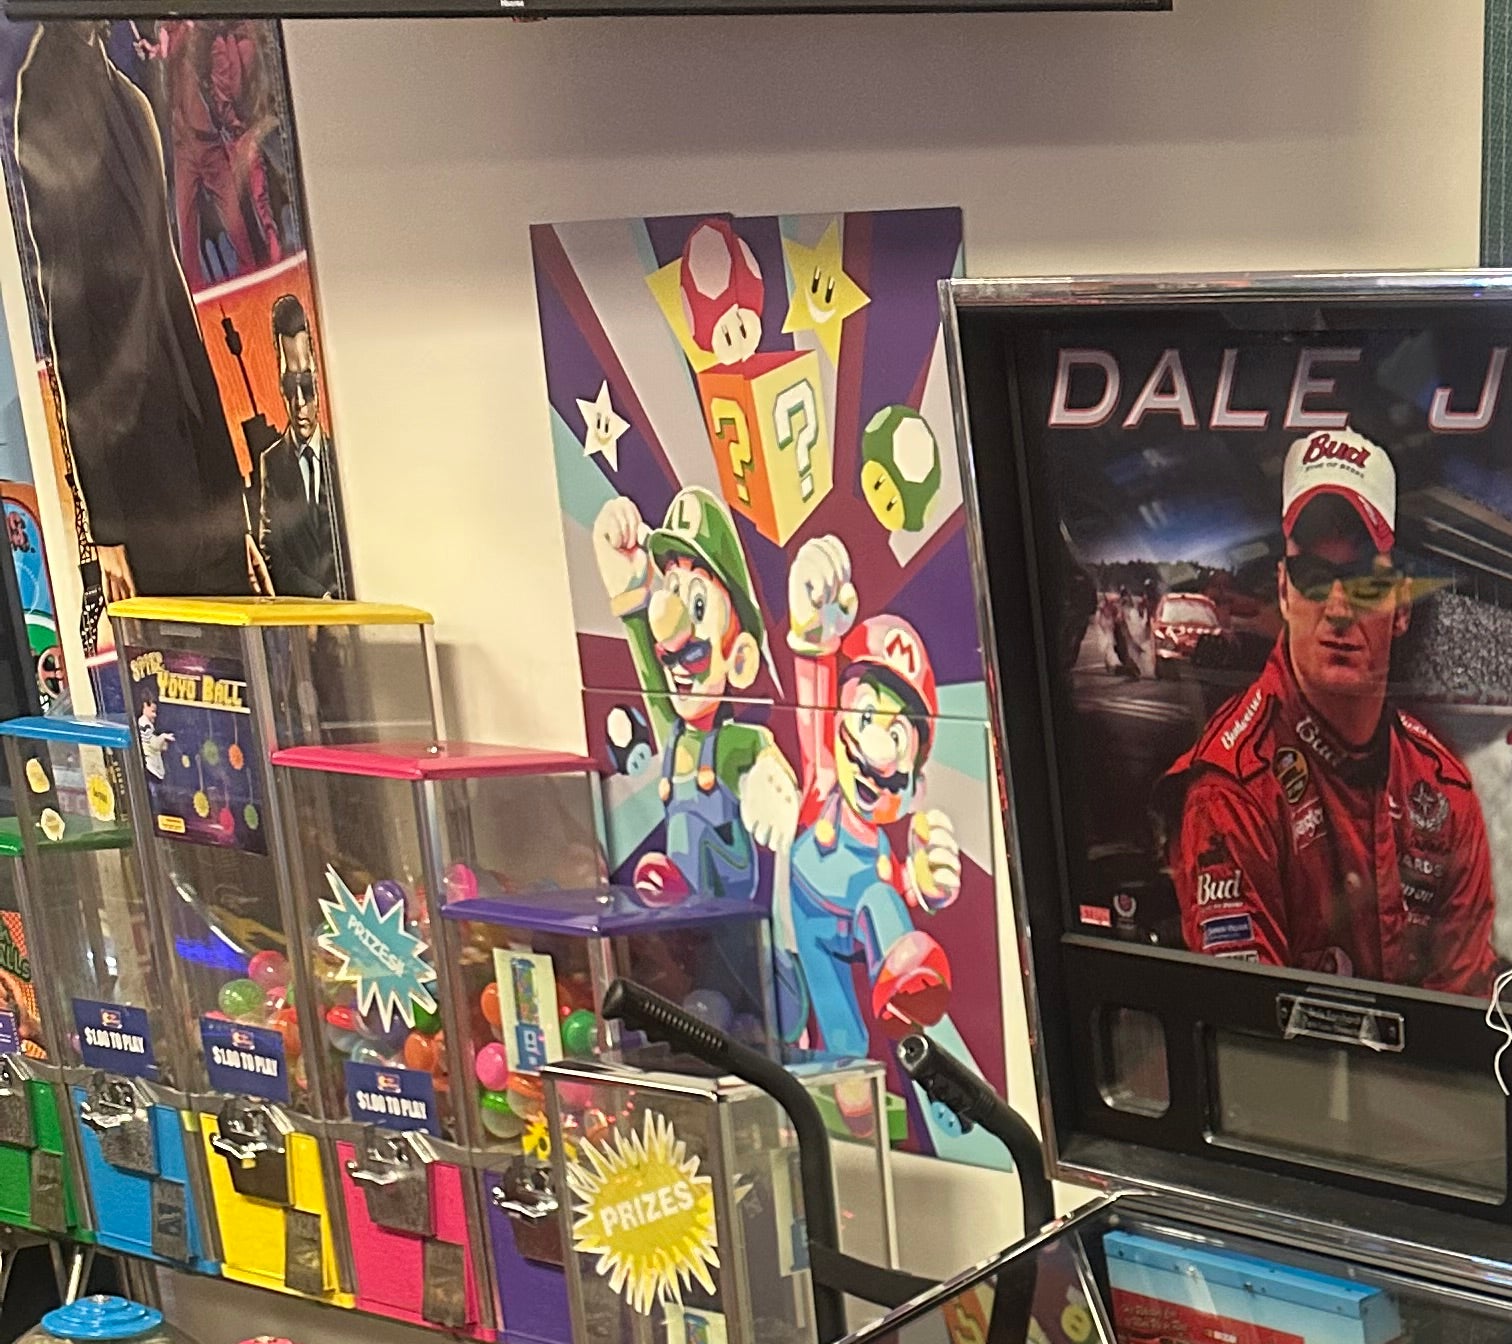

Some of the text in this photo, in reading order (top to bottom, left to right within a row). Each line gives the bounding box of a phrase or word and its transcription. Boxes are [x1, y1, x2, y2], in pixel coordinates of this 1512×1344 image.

[1046, 346, 1363, 431] DALE
[1302, 433, 1371, 468] Bud
[156, 671, 243, 707] YOYO BALL
[1197, 869, 1242, 905] Bud
[111, 1031, 123, 1050] TO
[124, 1033, 145, 1054] PLAY
[241, 1050, 255, 1070] TO
[256, 1055, 279, 1077] PLAY
[385, 1095, 400, 1114] TO
[401, 1098, 427, 1120] PLAY
[600, 1179, 695, 1238] PRIZES
